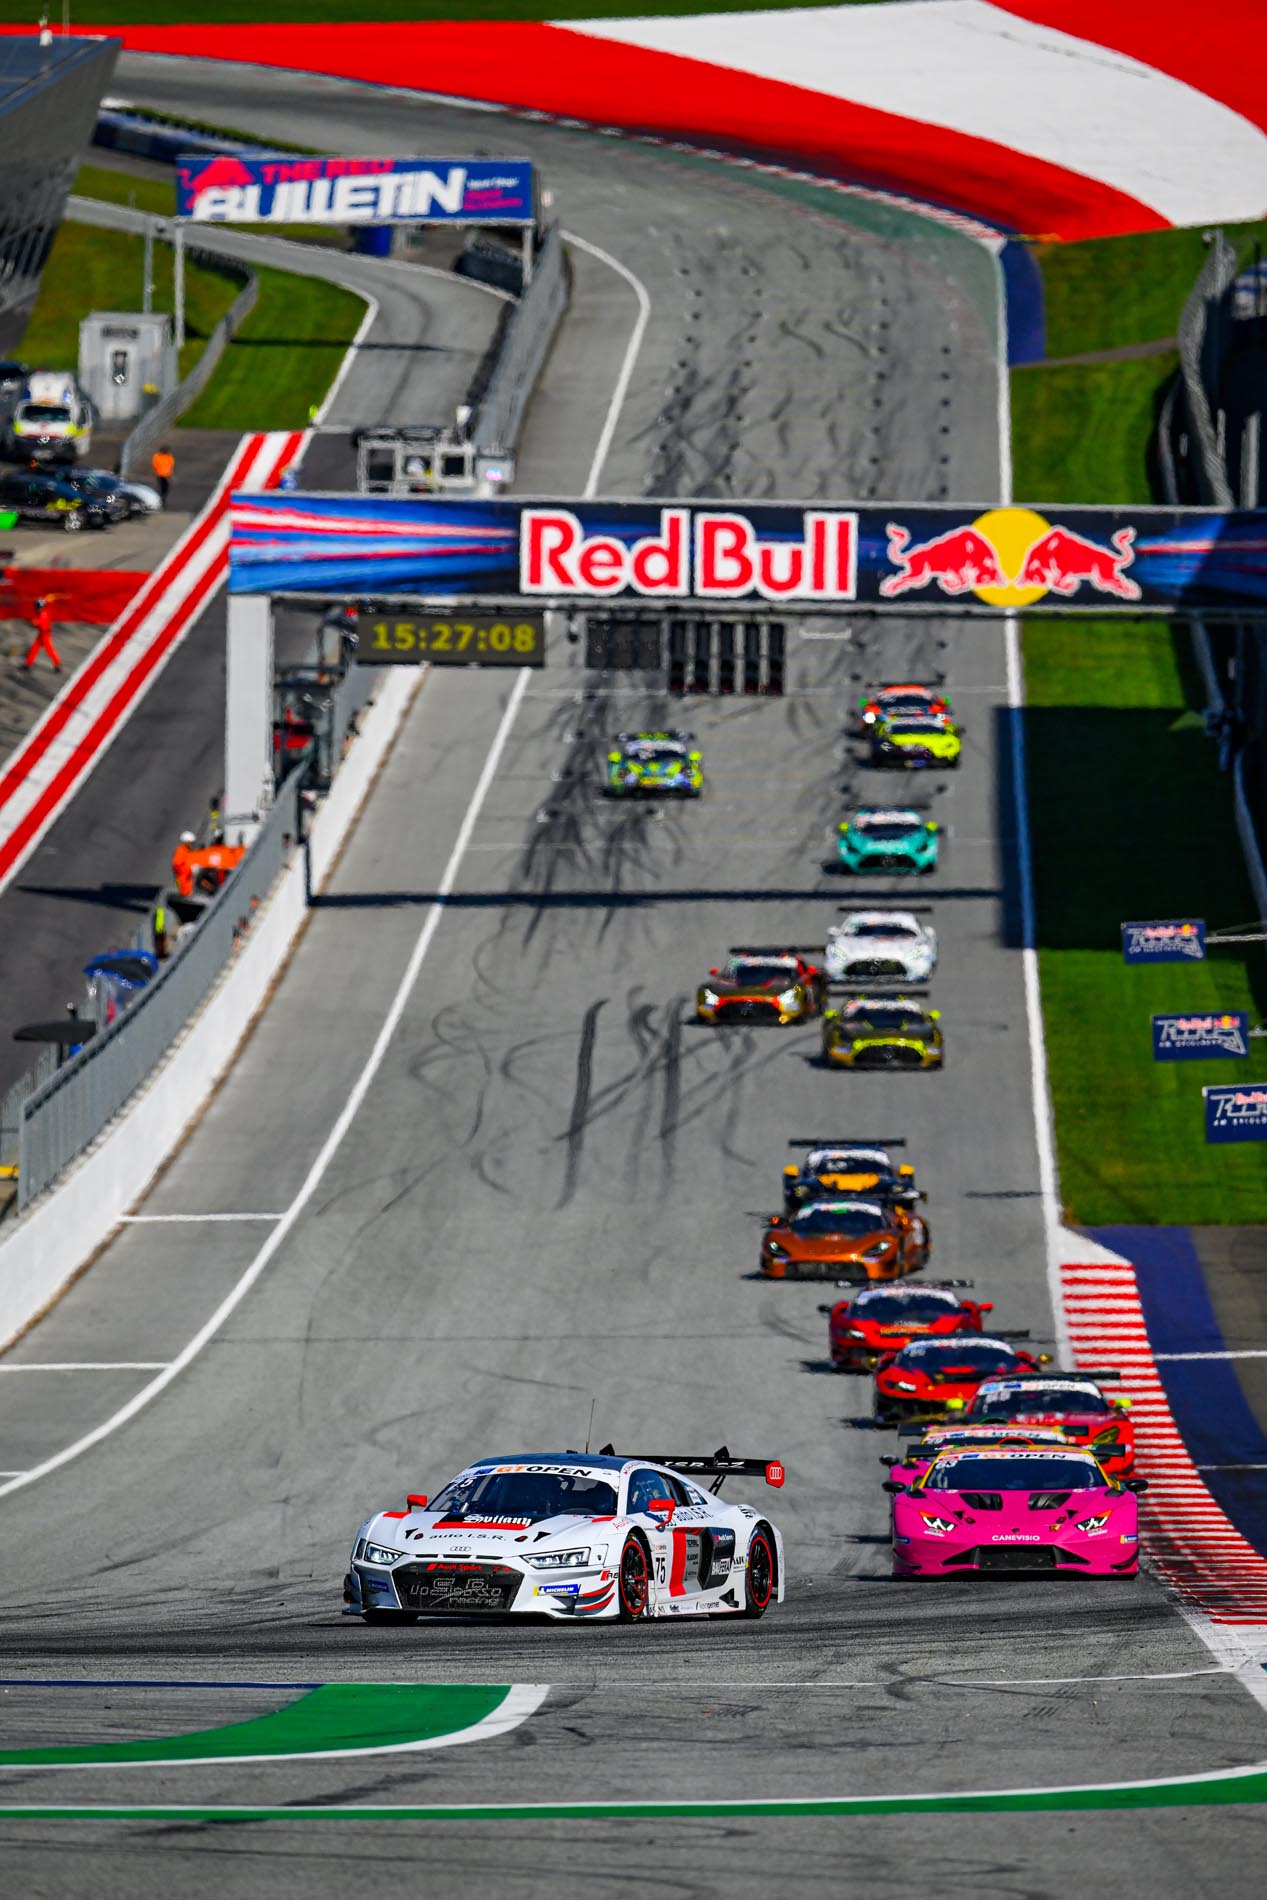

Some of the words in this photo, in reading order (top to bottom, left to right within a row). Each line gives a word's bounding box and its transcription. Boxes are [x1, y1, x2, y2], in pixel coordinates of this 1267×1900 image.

[261, 161, 323, 184] THE
[325, 159, 396, 178] RED
[193, 168, 467, 222] BULLETIN
[522, 510, 689, 595] Red
[695, 512, 857, 598] Bull
[371, 622, 537, 653] 15:27:08
[459, 1563, 483, 1571] Sport
[655, 1557, 666, 1585] 75
